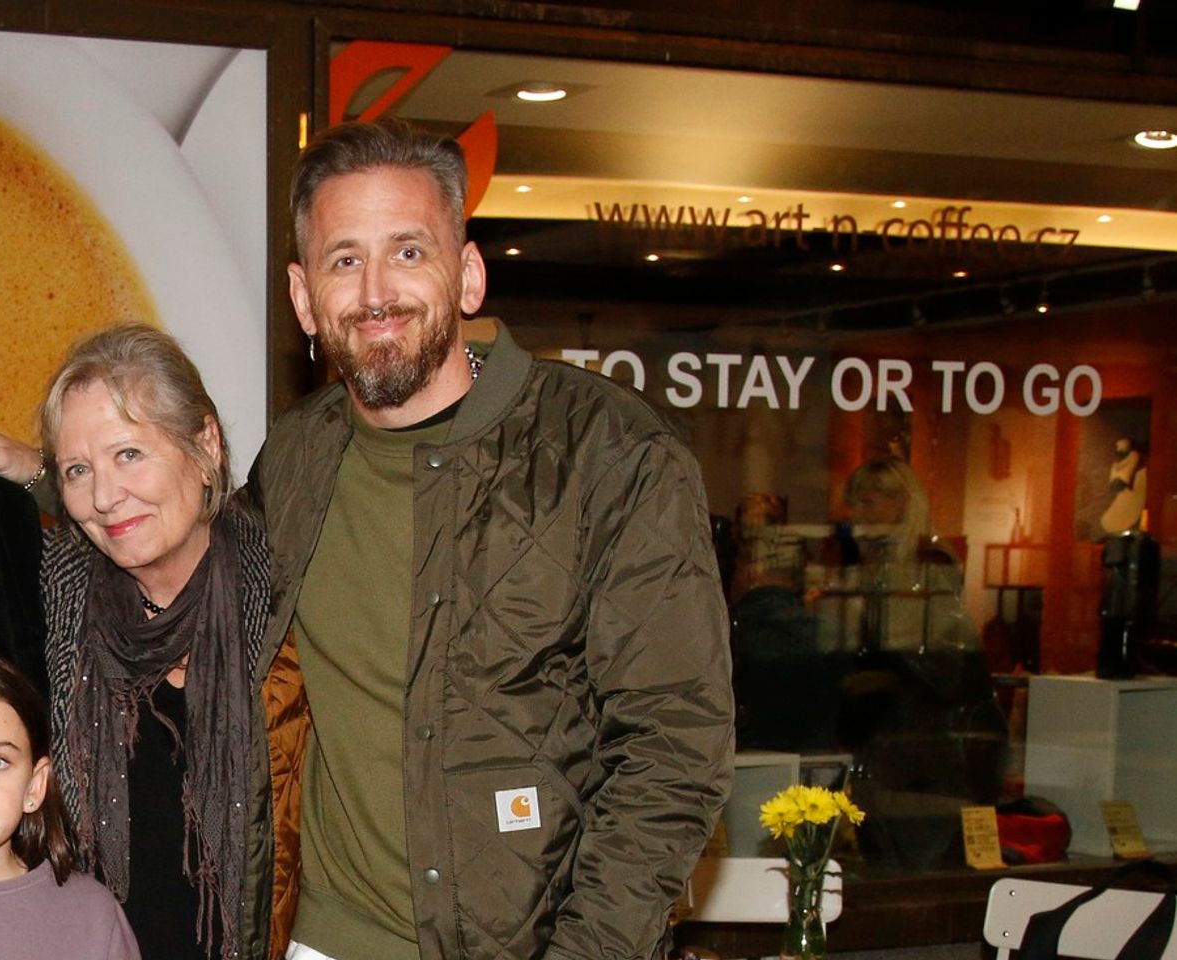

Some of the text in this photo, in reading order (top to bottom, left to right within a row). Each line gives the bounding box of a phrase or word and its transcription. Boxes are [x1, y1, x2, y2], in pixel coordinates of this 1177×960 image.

[665, 351, 816, 409] STAY
[831, 357, 914, 412] OR
[932, 360, 1005, 415] TO
[1023, 363, 1103, 417] GO
